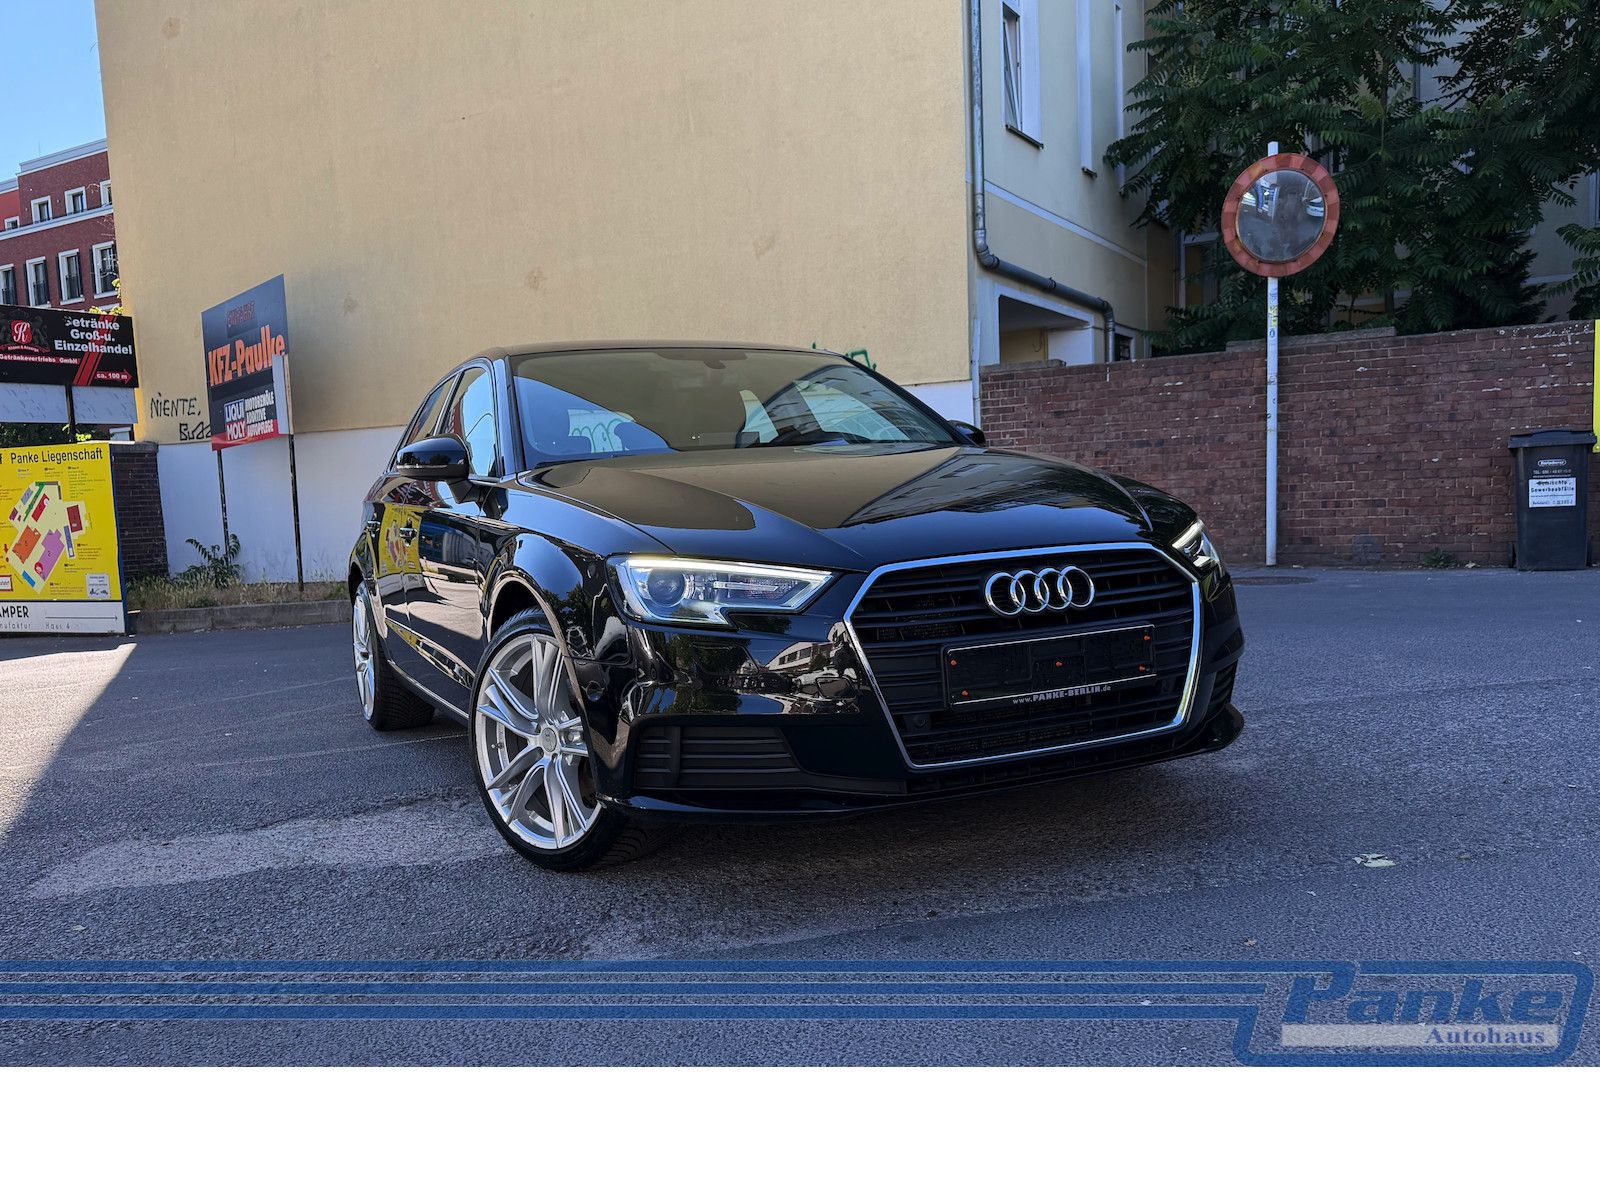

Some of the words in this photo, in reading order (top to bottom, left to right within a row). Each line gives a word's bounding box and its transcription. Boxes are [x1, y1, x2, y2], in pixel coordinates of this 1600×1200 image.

[54, 339, 133, 355] Einzelhandel
[208, 324, 285, 387] KFZ-Paulke
[108, 372, 120, 380] 100
[225, 401, 245, 422] LIQUI
[227, 420, 246, 441] MOLY
[10, 452, 39, 464] Panke
[41, 447, 103, 464] Liegenschaft
